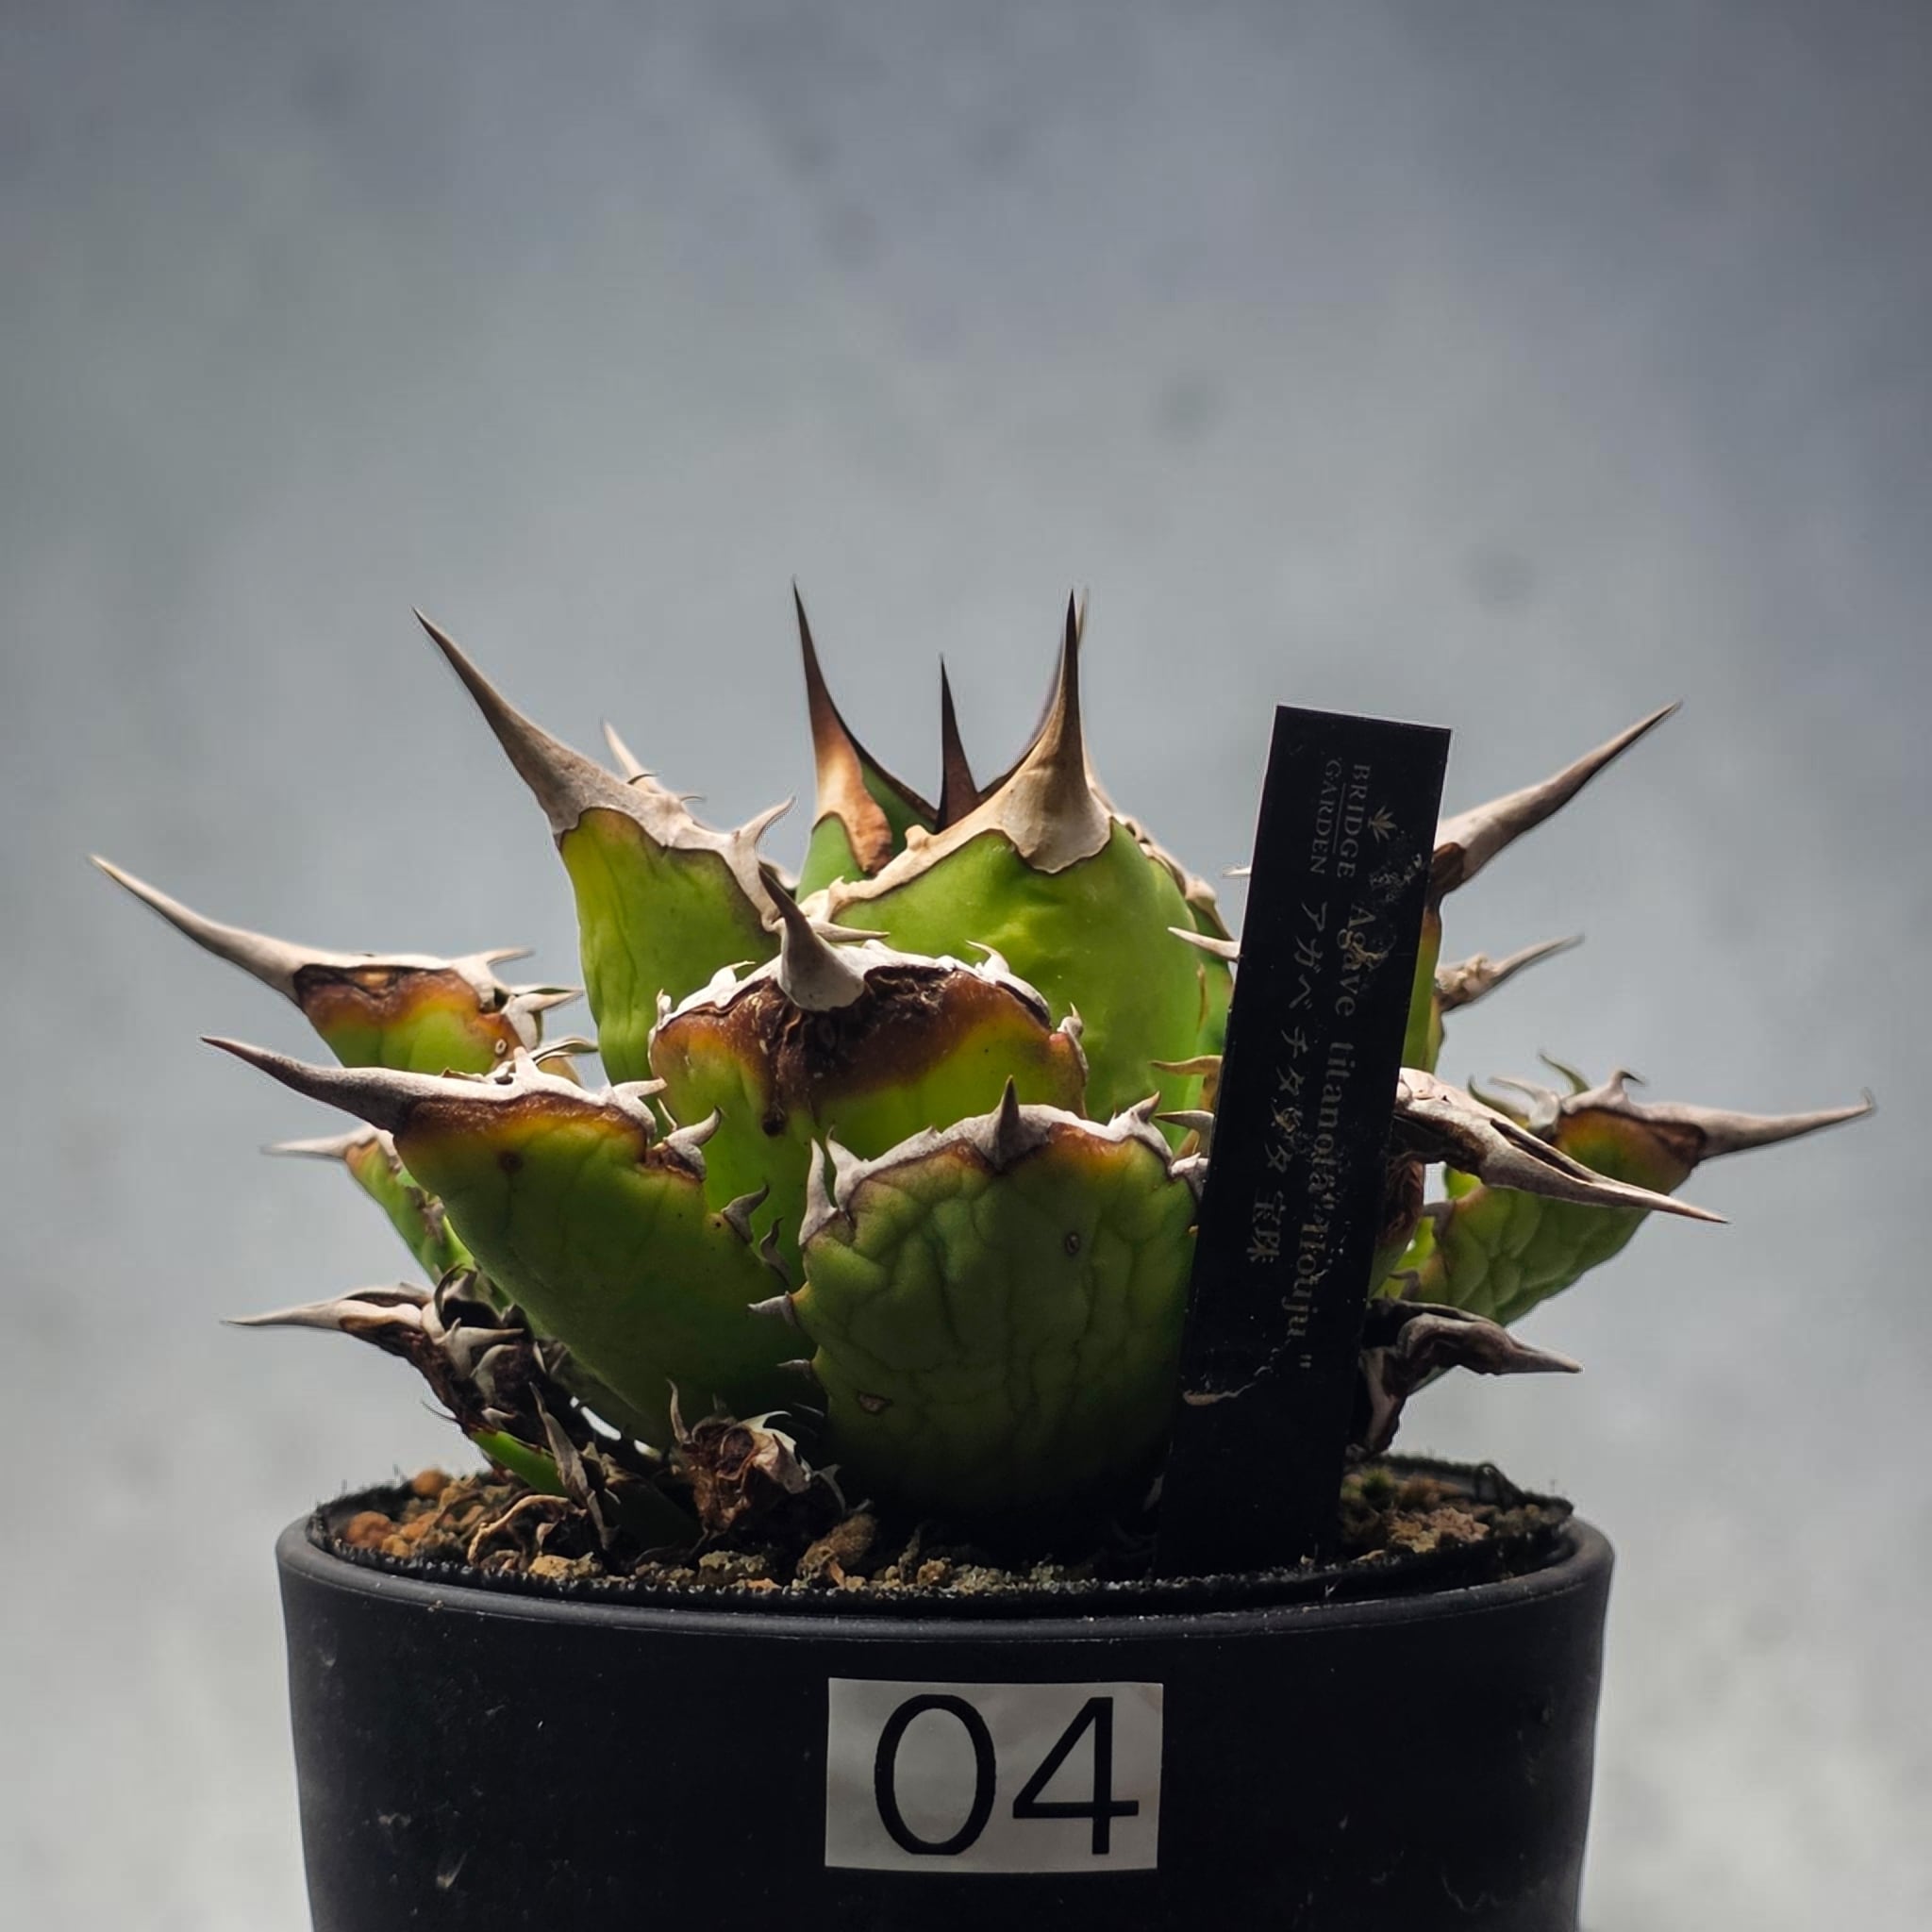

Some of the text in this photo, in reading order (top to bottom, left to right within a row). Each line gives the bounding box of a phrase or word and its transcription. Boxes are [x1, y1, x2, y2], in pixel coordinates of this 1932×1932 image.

[1310, 758, 1341, 875] GARDEN
[1337, 763, 1370, 878] BRIDGE
[1336, 903, 1376, 1017] Agave
[874, 1694, 1139, 1856] 04
